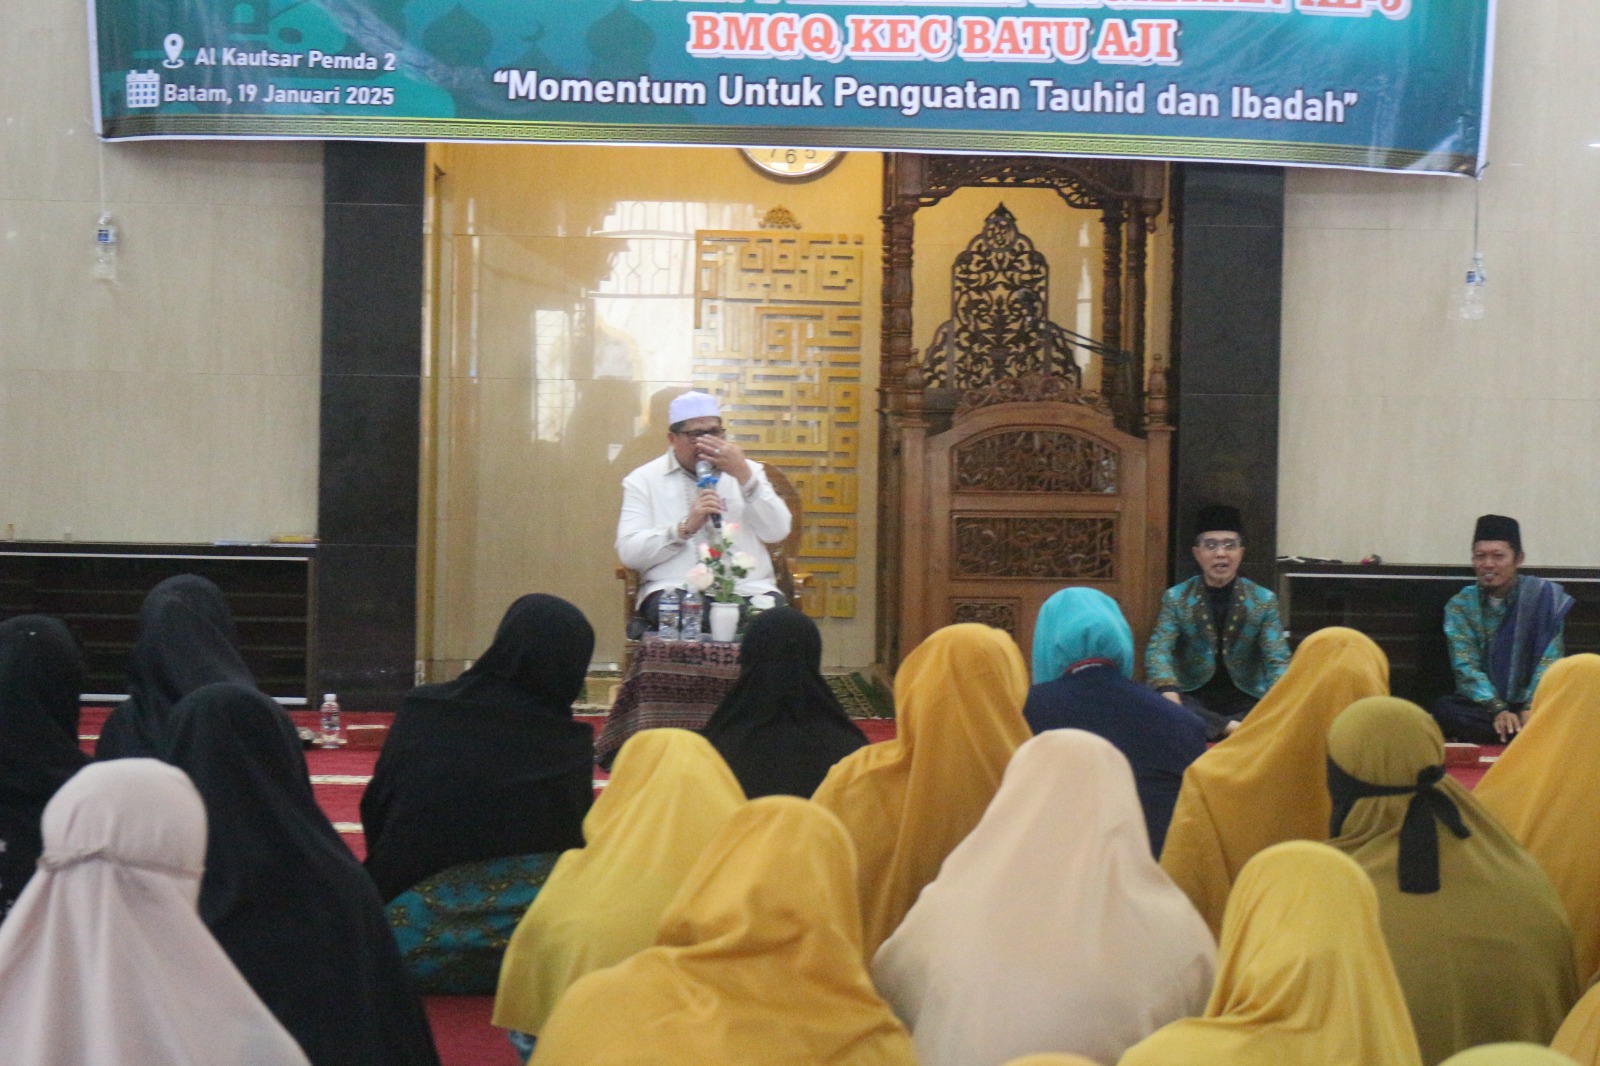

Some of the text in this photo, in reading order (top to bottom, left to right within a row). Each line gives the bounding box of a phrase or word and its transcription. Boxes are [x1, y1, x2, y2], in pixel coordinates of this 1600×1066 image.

[689, 14, 1178, 61] BMGQ KEC BATU AJI
[194, 48, 396, 71] Al Kautsar Pemda 2
[163, 83, 395, 105] Batam, 19 Januari 2025
[718, 75, 823, 107] Untuk
[834, 76, 1020, 116] Penguatan
[1029, 79, 1146, 114] Tauhid
[1156, 83, 1219, 117] dan
